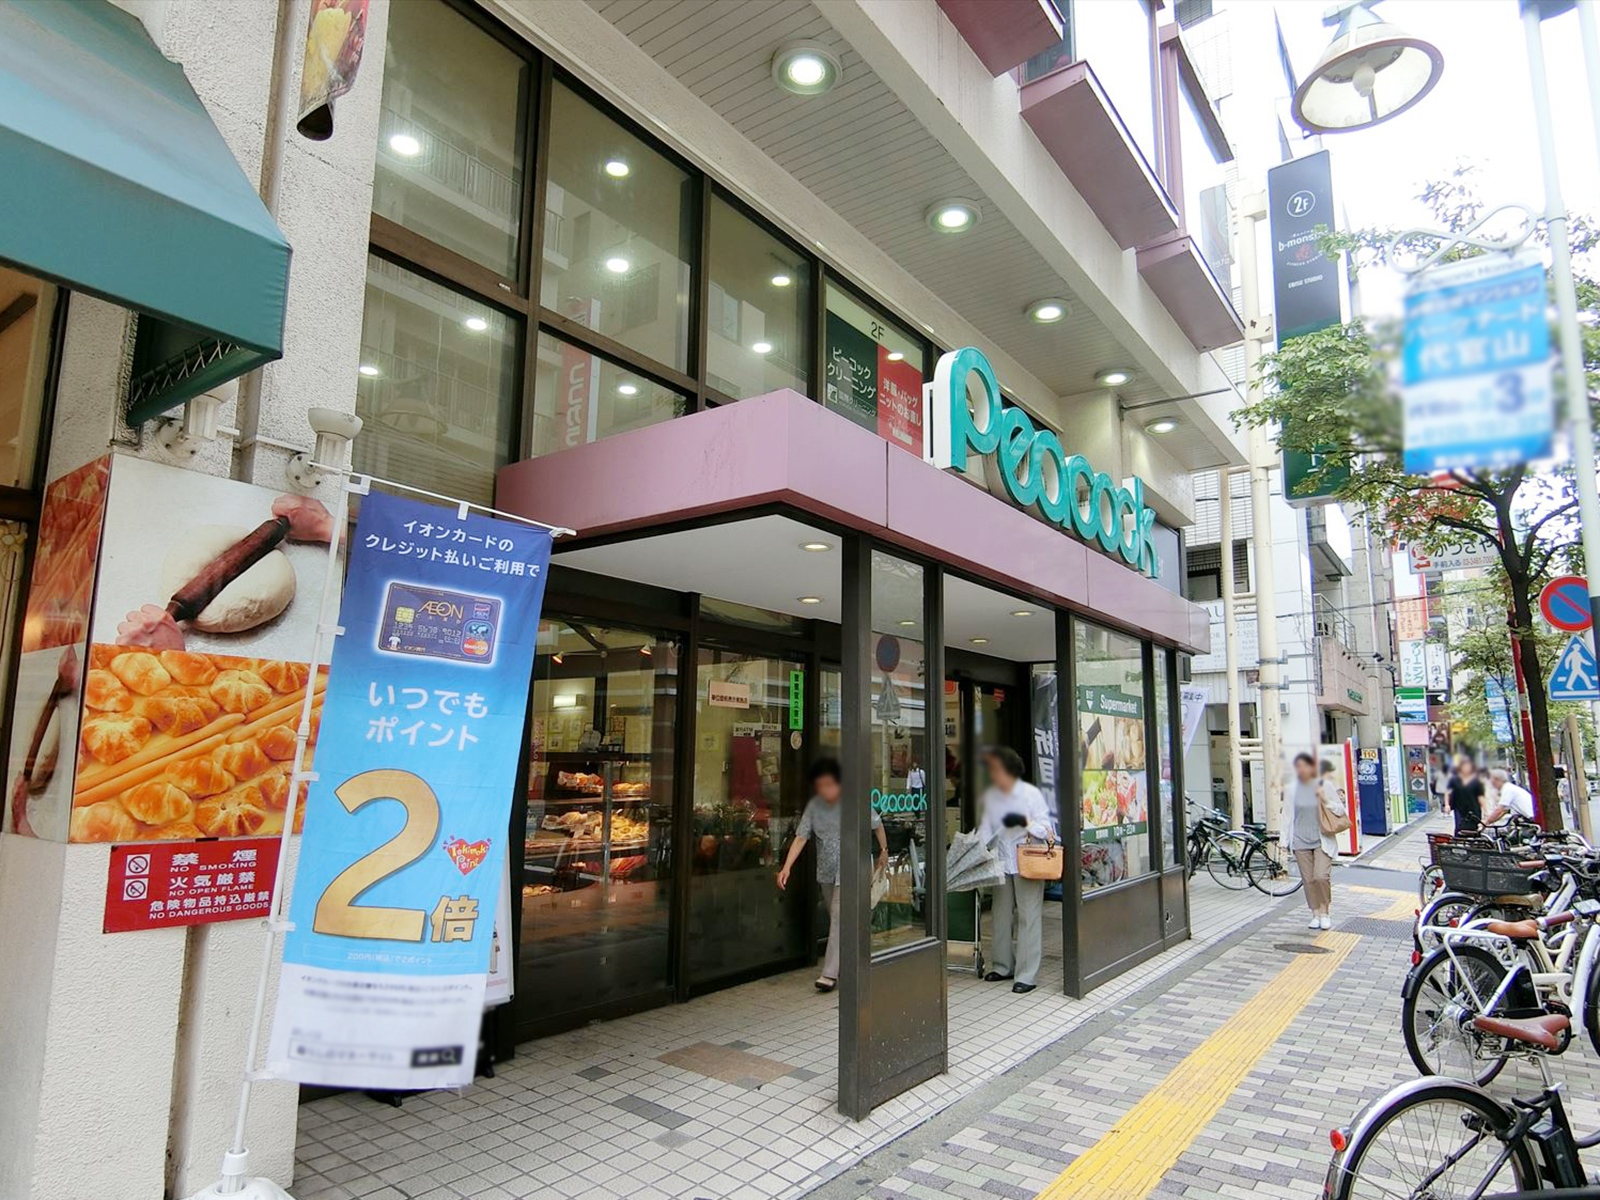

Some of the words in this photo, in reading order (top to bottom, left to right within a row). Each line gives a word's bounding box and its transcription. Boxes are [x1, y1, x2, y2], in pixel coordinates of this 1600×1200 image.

[1293, 196, 1309, 214] 2F
[870, 321, 885, 341] 2F
[832, 346, 871, 379] ピーコック
[827, 362, 877, 399] クリーニング
[934, 346, 1159, 580] Peacock
[403, 520, 514, 552] イオンカードの
[365, 533, 541, 578] クレジット払いご利用で
[368, 681, 489, 720] いつでも
[1100, 694, 1137, 714] Supermarket
[365, 715, 480, 752] ポイント
[870, 788, 928, 812] Peacock
[172, 849, 257, 867] 禁煙
[199, 861, 257, 871] SMOKING
[169, 871, 256, 890] 火気厳禁
[169, 889, 185, 897] NO
[188, 887, 218, 895] OPEN
[221, 883, 254, 893] FLAME
[149, 912, 165, 920] NO
[168, 905, 232, 918] DANGEROUS
[235, 901, 270, 911] GOODS
[150, 891, 270, 913] 危険物品持込厳禁
